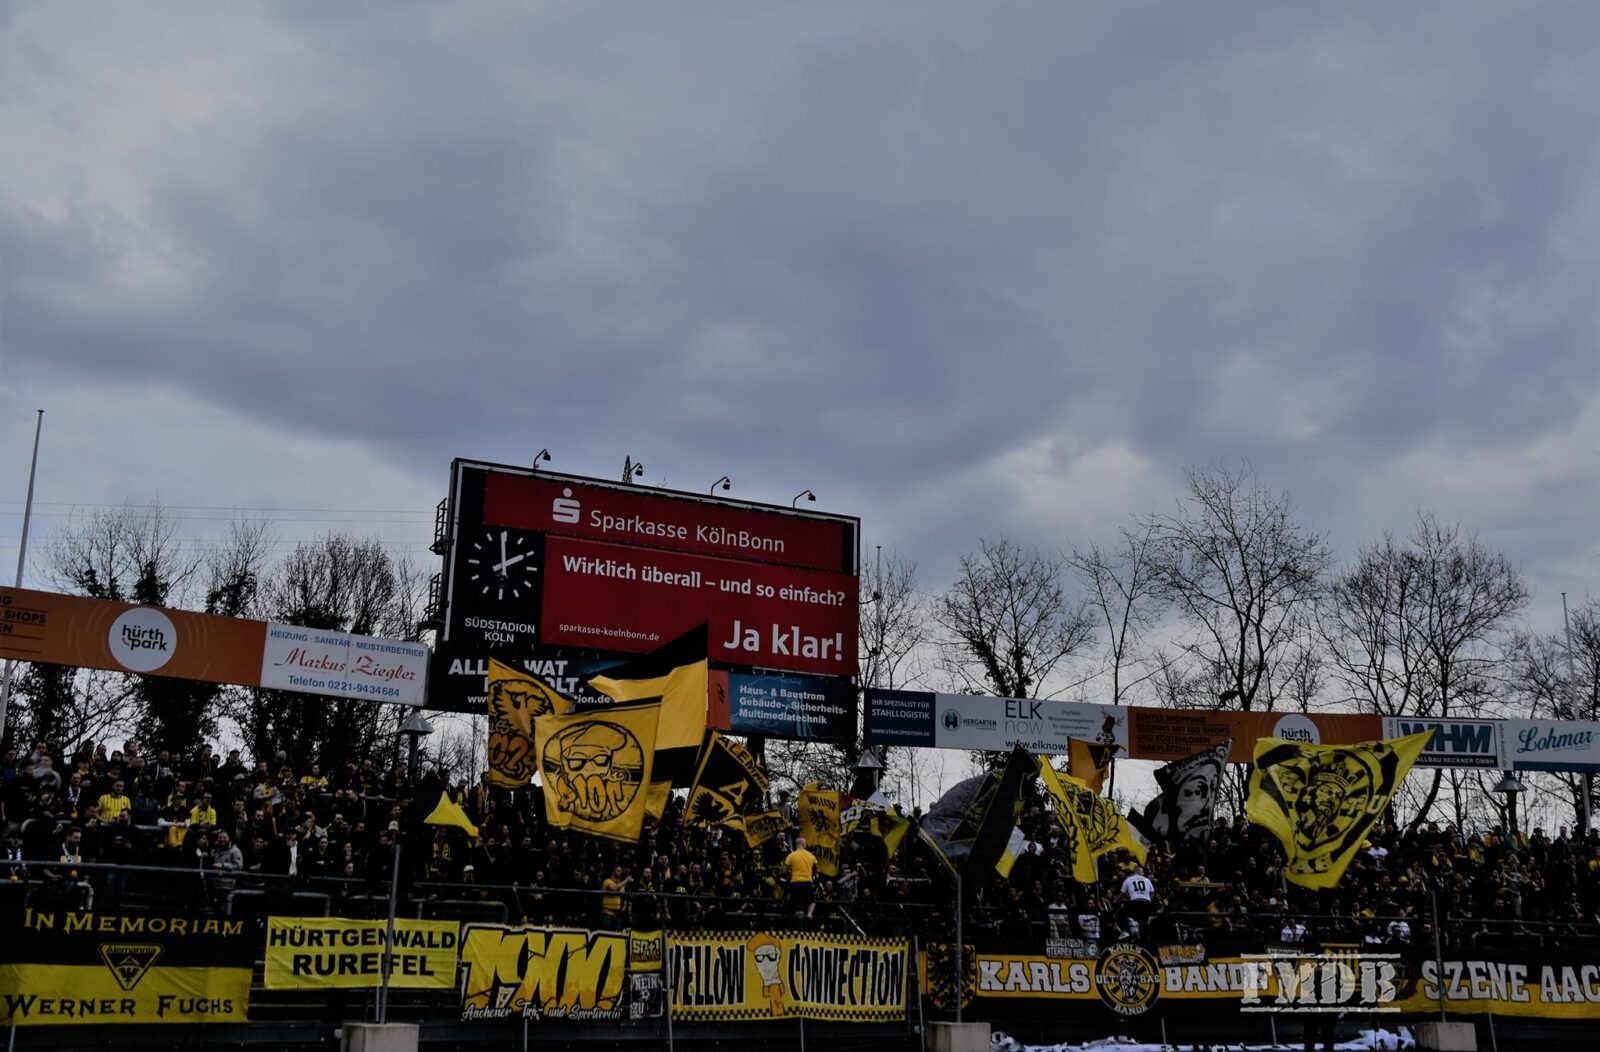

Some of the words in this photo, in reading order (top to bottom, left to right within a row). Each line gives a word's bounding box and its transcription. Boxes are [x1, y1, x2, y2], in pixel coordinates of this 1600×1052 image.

[590, 509, 688, 540] Sparkasse
[695, 524, 785, 553] KölnBonn
[563, 555, 637, 580] Wirklich
[641, 565, 701, 589] überall
[720, 578, 752, 595] und
[756, 584, 775, 599] so
[779, 585, 846, 607] einfach?
[5, 610, 46, 624] SHOPS
[464, 616, 536, 634] SÜDSTADION
[122, 624, 164, 642] hürth
[484, 630, 515, 643] KÖLN
[559, 624, 660, 642] sparkasse-koelnbonn.de
[723, 619, 760, 653] Ja
[771, 623, 843, 662] klar!
[130, 638, 168, 651] park
[270, 630, 309, 642] HEIZUNG
[356, 641, 425, 658] MEISTERBETRIEB
[274, 647, 347, 673] Markus
[351, 655, 417, 683] Ziegler
[448, 658, 488, 676] ALL
[524, 660, 569, 677] WAT
[288, 675, 325, 689] Telefon
[328, 680, 401, 697] 0221-9434684
[739, 684, 768, 696] Haus-
[770, 688, 778, 697] &
[780, 688, 825, 701] Baustrom
[739, 697, 789, 713] Gebäude-,
[791, 701, 848, 714] Sicherheits-
[884, 700, 916, 708] SPEZIALIST
[917, 701, 931, 709] FÜR
[1005, 700, 1043, 720] ELK
[739, 708, 828, 725] Multimediatechnik
[871, 708, 931, 720] STAHLLOGISTIK
[962, 718, 997, 727] HERGARTEN
[1005, 720, 1043, 735] now
[1281, 728, 1310, 738] hürth
[1517, 727, 1593, 753] Lohmar
[1132, 881, 1145, 892] 10
[63, 911, 244, 937] MEMORIAM
[270, 926, 456, 948] HÜRTGENWALD
[634, 977, 657, 991] NEIN
[669, 944, 746, 1005] YELLOW
[787, 944, 904, 1006] CONNECTION
[979, 959, 1091, 993] KARLS
[1421, 959, 1530, 1003] SZENE
